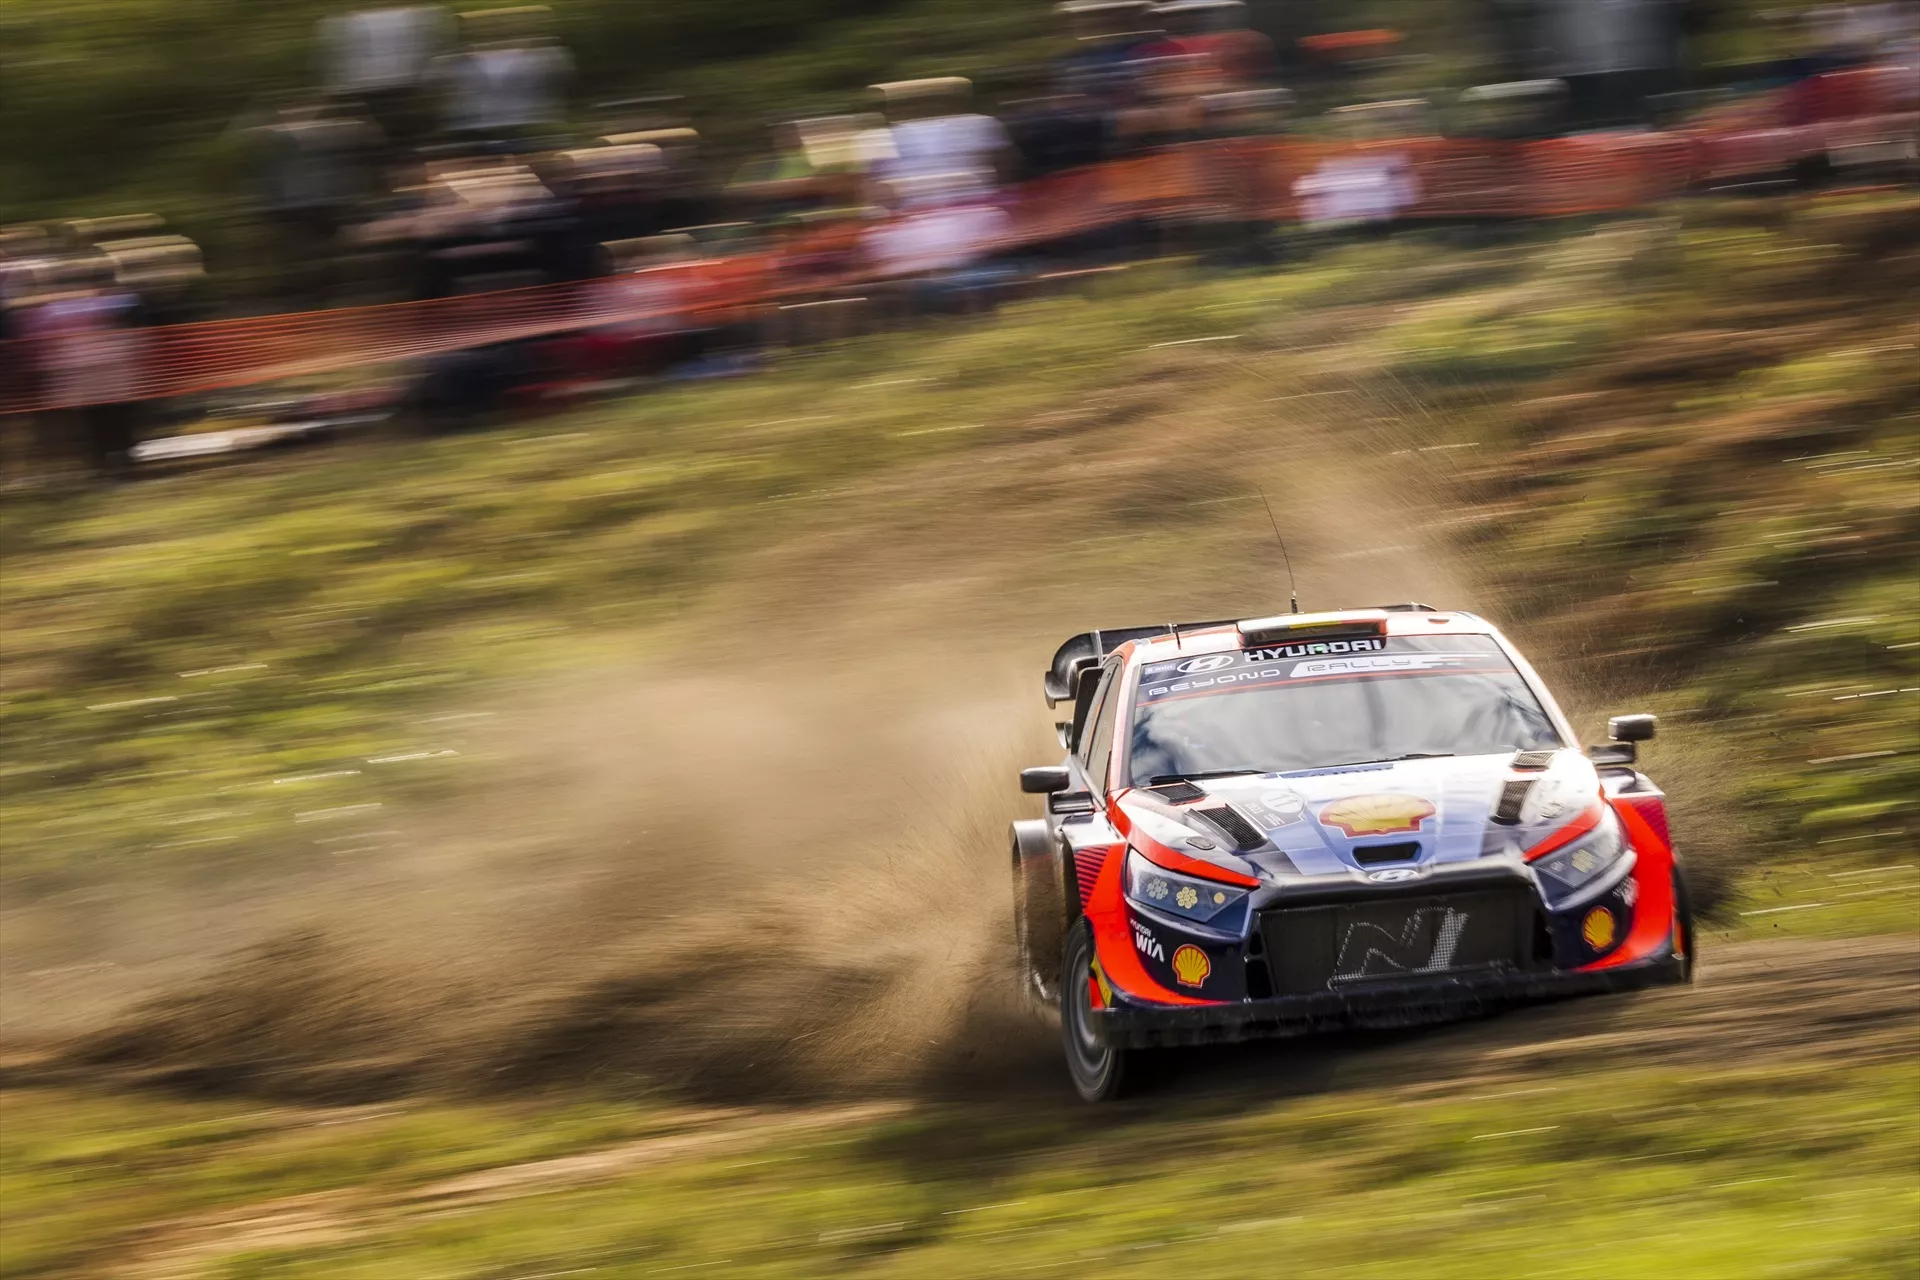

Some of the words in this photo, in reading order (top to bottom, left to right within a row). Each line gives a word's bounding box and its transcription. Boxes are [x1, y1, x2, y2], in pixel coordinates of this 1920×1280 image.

[1243, 639, 1383, 663] HYUNDAI
[1148, 669, 1280, 696] BEYOND
[1307, 659, 1411, 672] RALLY
[1130, 917, 1152, 937] HYUNDAI
[1135, 931, 1165, 963] WIA
